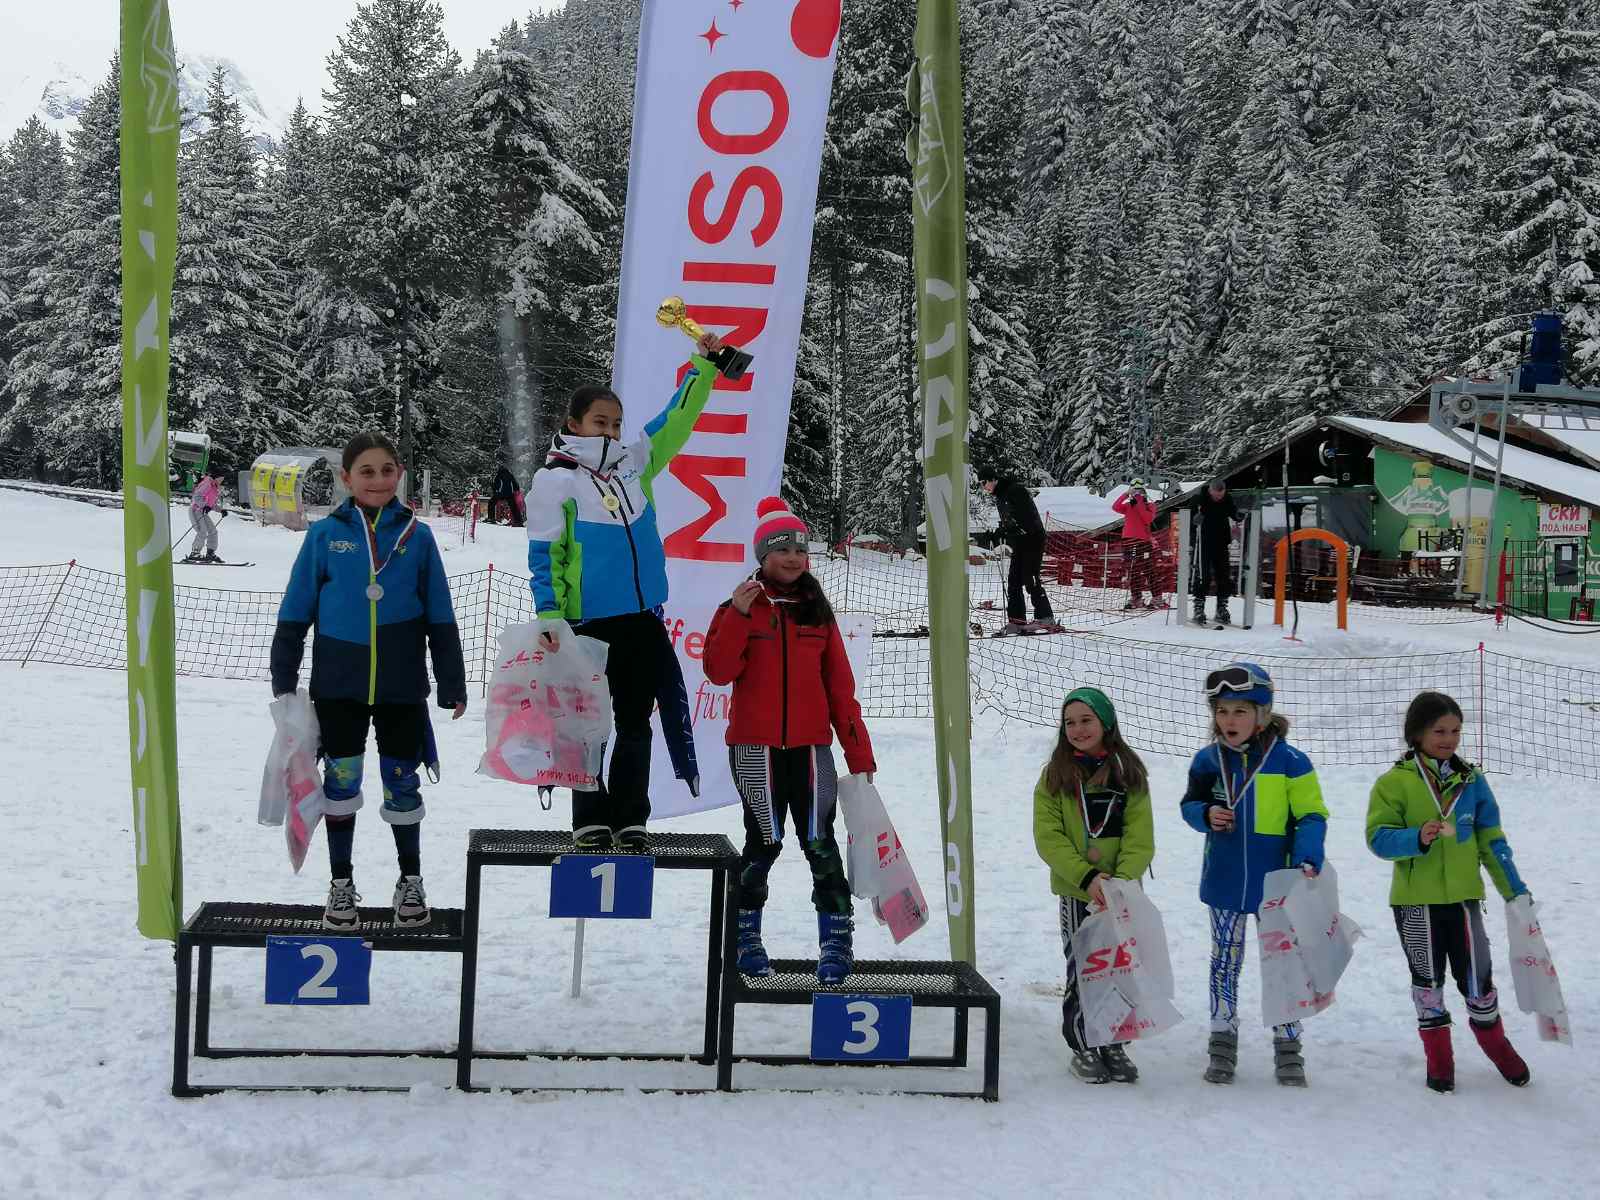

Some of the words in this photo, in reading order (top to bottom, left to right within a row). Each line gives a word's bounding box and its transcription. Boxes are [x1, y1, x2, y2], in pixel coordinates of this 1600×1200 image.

[663, 70, 790, 562] MINISO
[1541, 523, 1561, 533] ПОД
[1562, 523, 1587, 533] НАЕМ
[1548, 505, 1581, 521] СКИ
[591, 862, 616, 913] 1
[298, 943, 339, 999] 2
[842, 1001, 880, 1055] 3
